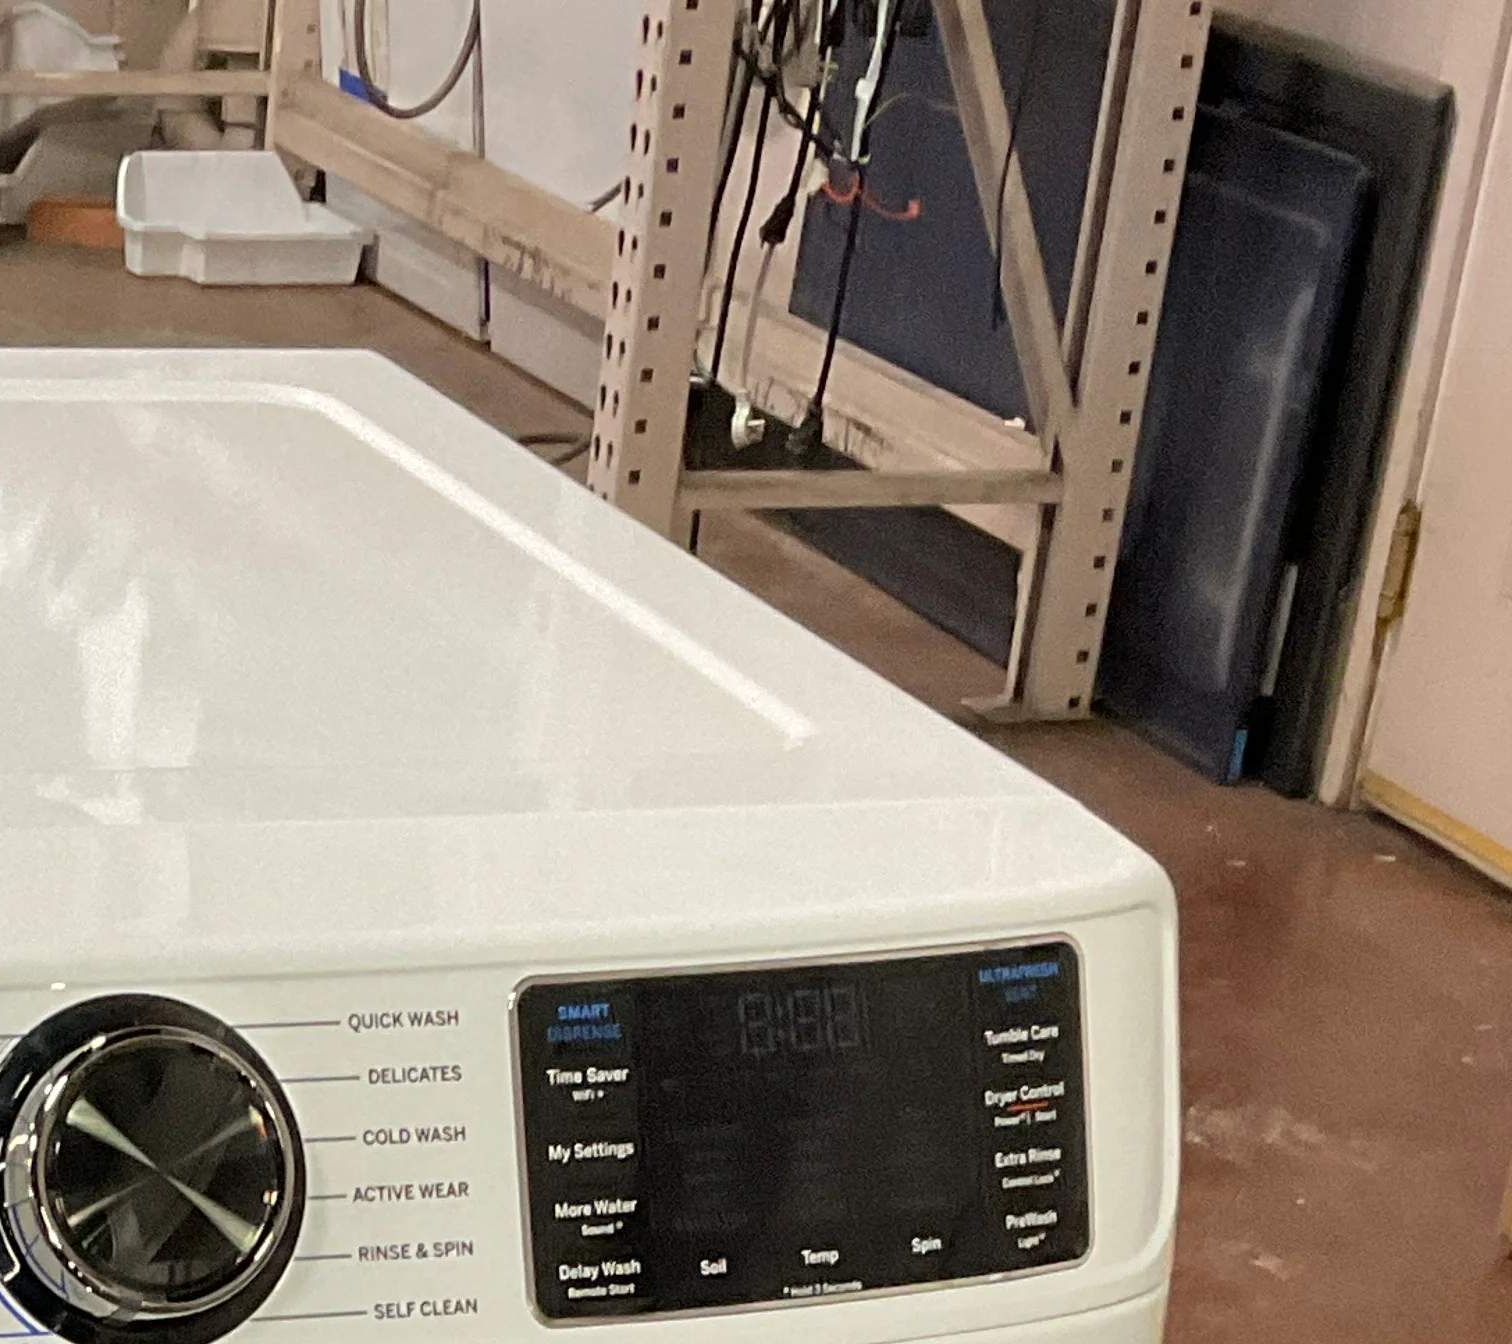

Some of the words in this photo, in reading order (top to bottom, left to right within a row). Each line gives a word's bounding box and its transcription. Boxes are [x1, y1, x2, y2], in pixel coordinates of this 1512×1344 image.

[348, 1012, 404, 1033] QUICK
[408, 1010, 459, 1027] WASH
[557, 1003, 610, 1020] SMART
[1030, 1025, 1059, 1040] Care
[368, 1065, 463, 1085] DELICATES
[546, 1068, 583, 1085] Time
[586, 1067, 629, 1083] Saver
[984, 1090, 1018, 1108] Dryer
[1020, 1081, 1065, 1101] Control
[362, 1127, 411, 1146] COLD
[414, 1126, 467, 1143] WASH
[548, 1145, 571, 1164] My
[573, 1142, 635, 1160] Settings
[994, 1152, 1027, 1168] Extra
[352, 1184, 415, 1204] ACTIVE
[418, 1181, 470, 1200] WEAR
[554, 1202, 592, 1219] More
[594, 1199, 638, 1215] Water
[358, 1243, 412, 1262] RINSE
[415, 1242, 429, 1259] &
[432, 1240, 474, 1258] SPIN
[911, 1237, 942, 1254] Spin
[700, 1258, 728, 1276] Soil
[801, 1249, 839, 1265] Temp
[558, 1264, 599, 1281] Delay
[601, 1259, 641, 1276] Wash
[374, 1302, 416, 1320] SELF
[419, 1298, 478, 1317] CLEAN
